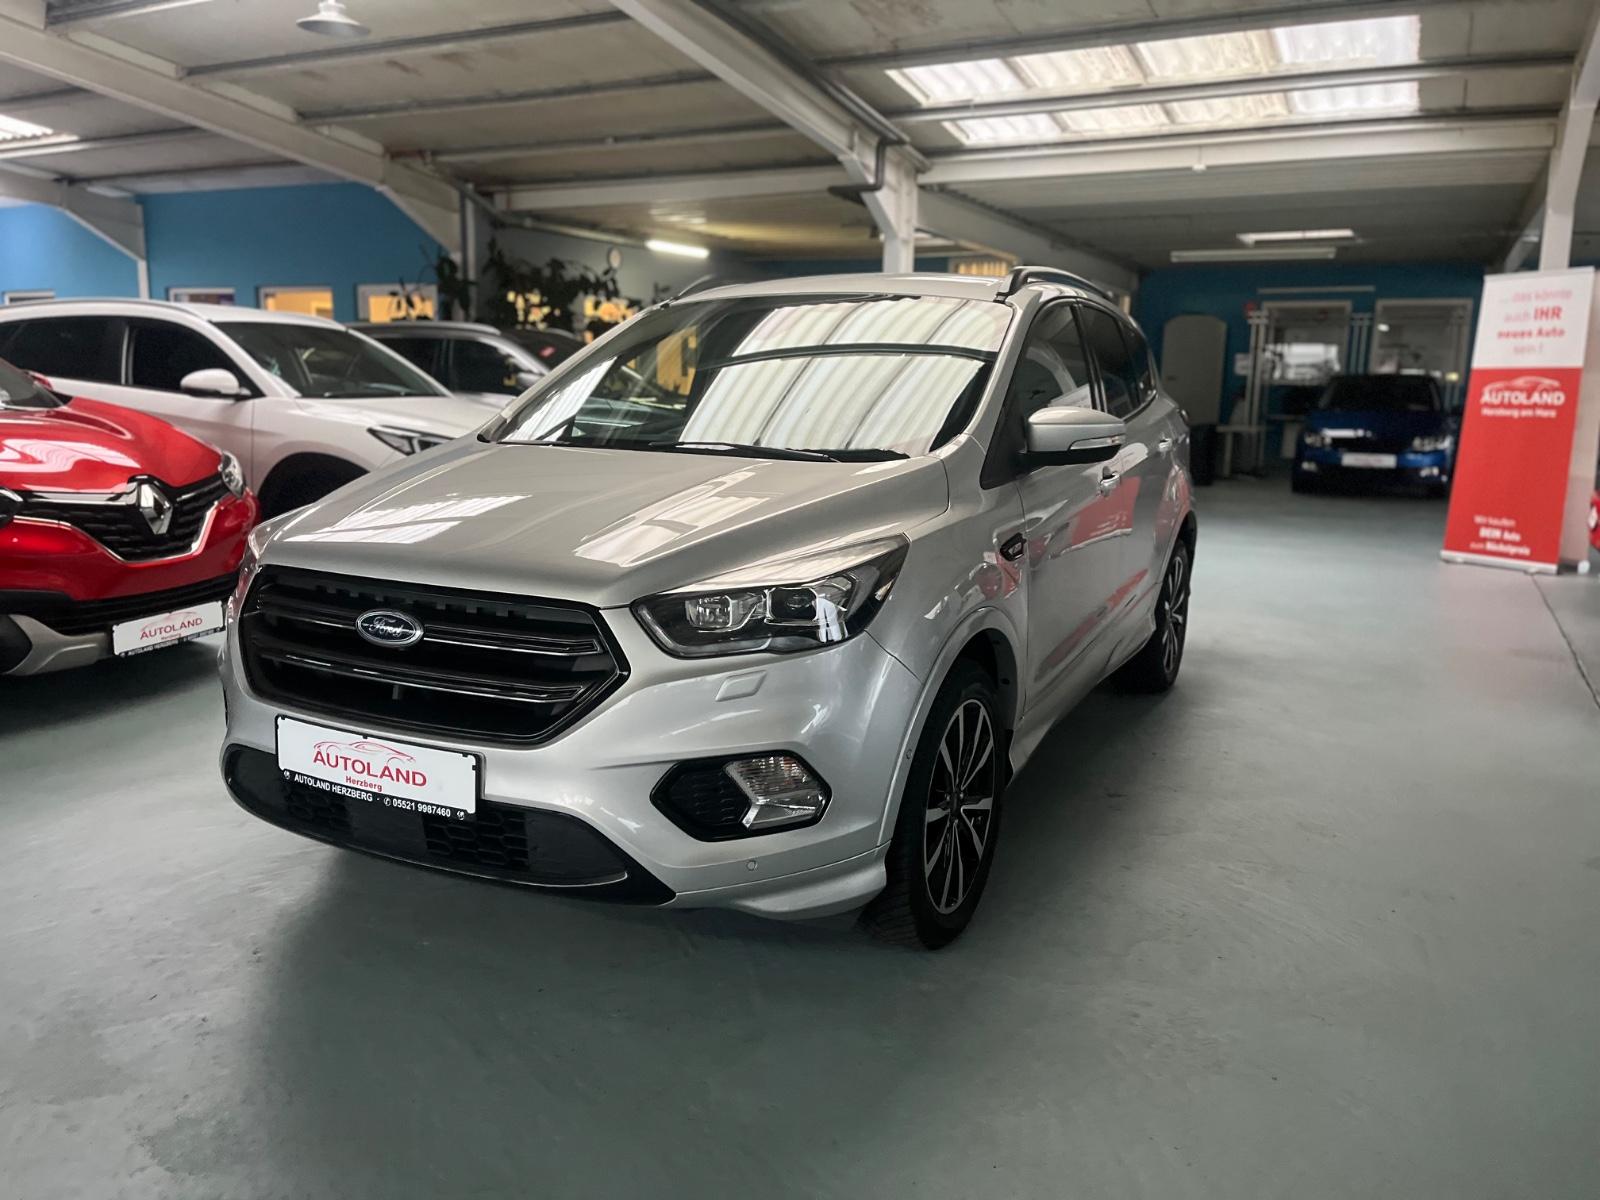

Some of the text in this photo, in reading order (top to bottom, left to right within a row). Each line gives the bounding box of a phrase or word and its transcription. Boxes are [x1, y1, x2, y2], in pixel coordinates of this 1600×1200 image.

[1533, 305, 1563, 321] IHR
[1536, 327, 1565, 338] Auto
[1480, 389, 1566, 406] AUTOLAND
[140, 617, 203, 640] AUTOLAND
[368, 615, 405, 638] Ford
[313, 750, 427, 787] AUTOLAND
[345, 775, 383, 792] Herzberg
[294, 773, 451, 818] AUTOLAND HERZBERG 05521 9987460
